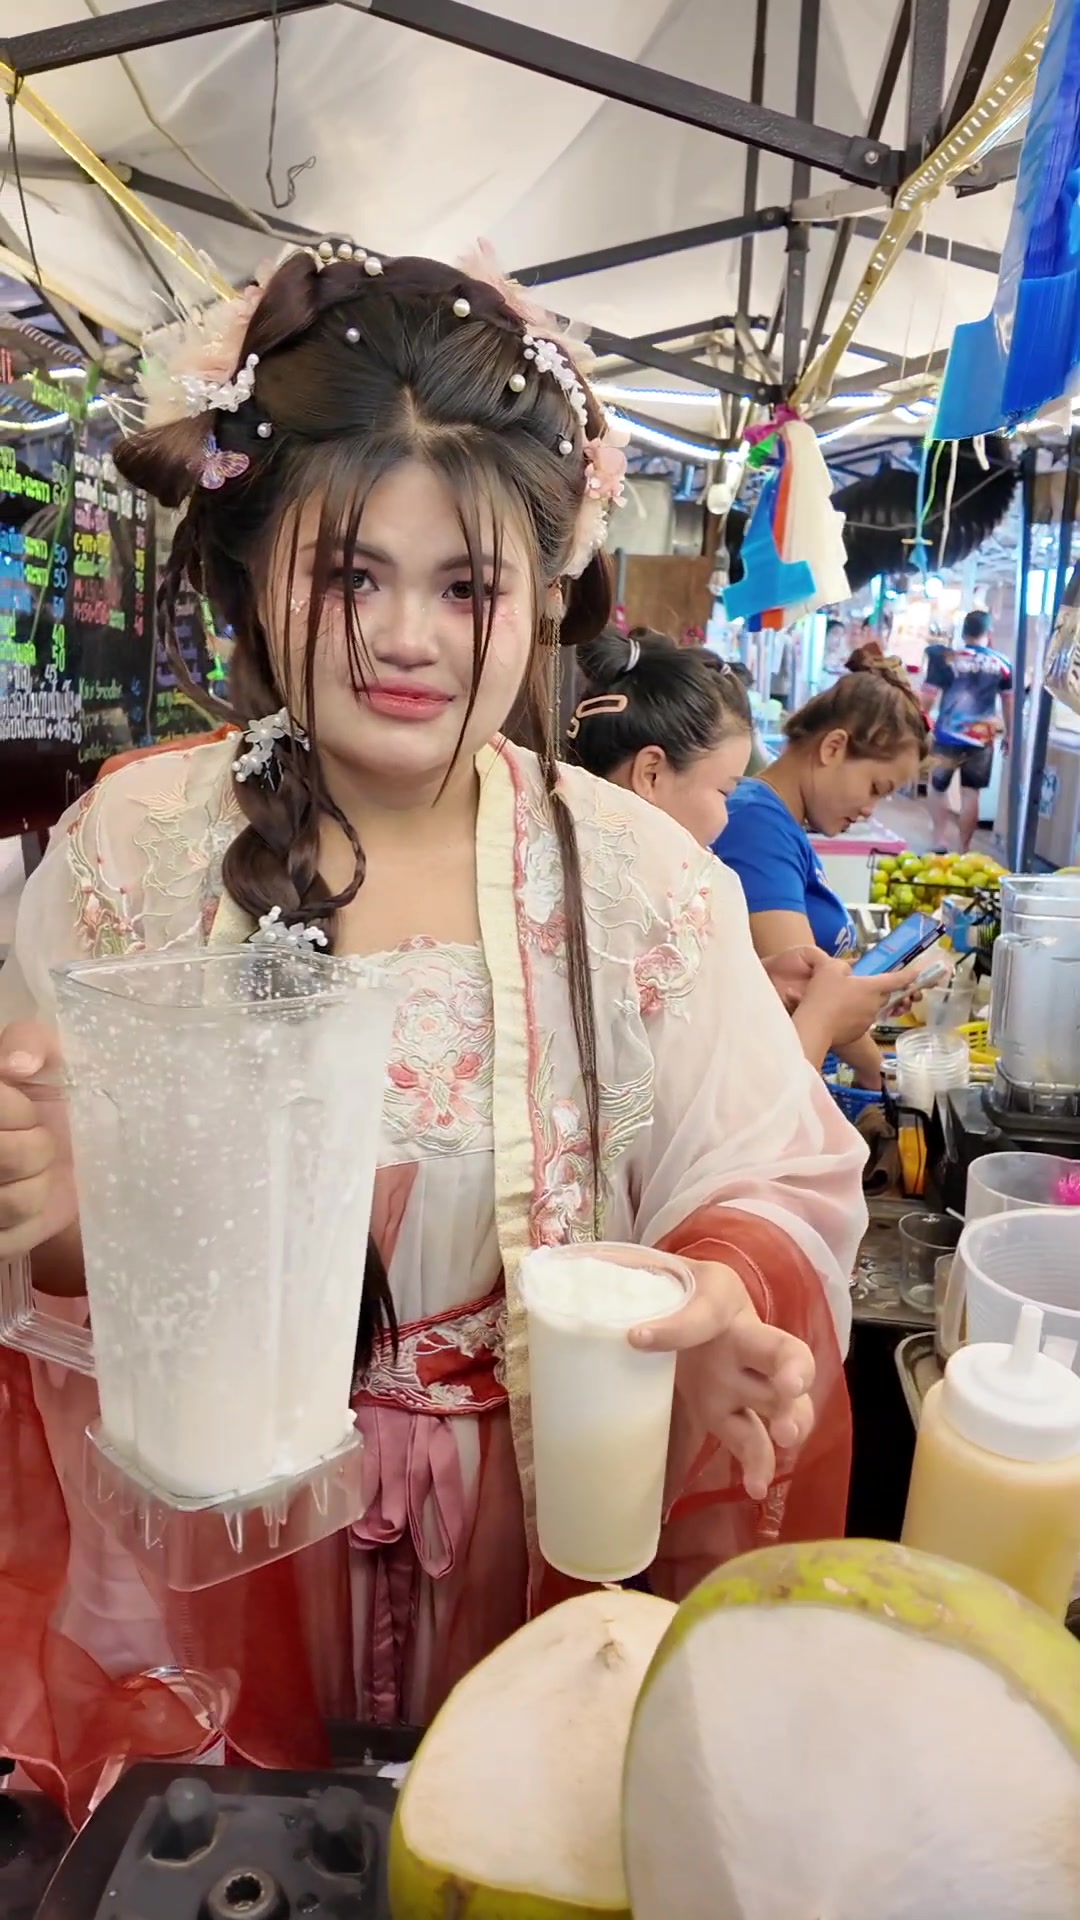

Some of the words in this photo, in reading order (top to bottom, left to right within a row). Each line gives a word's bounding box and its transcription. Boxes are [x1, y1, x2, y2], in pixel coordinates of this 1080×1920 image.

[53, 484, 67, 507] 60
[53, 543, 68, 566] 50
[53, 567, 68, 589] 50
[52, 645, 65, 673] 50
[72, 721, 83, 745] 50
